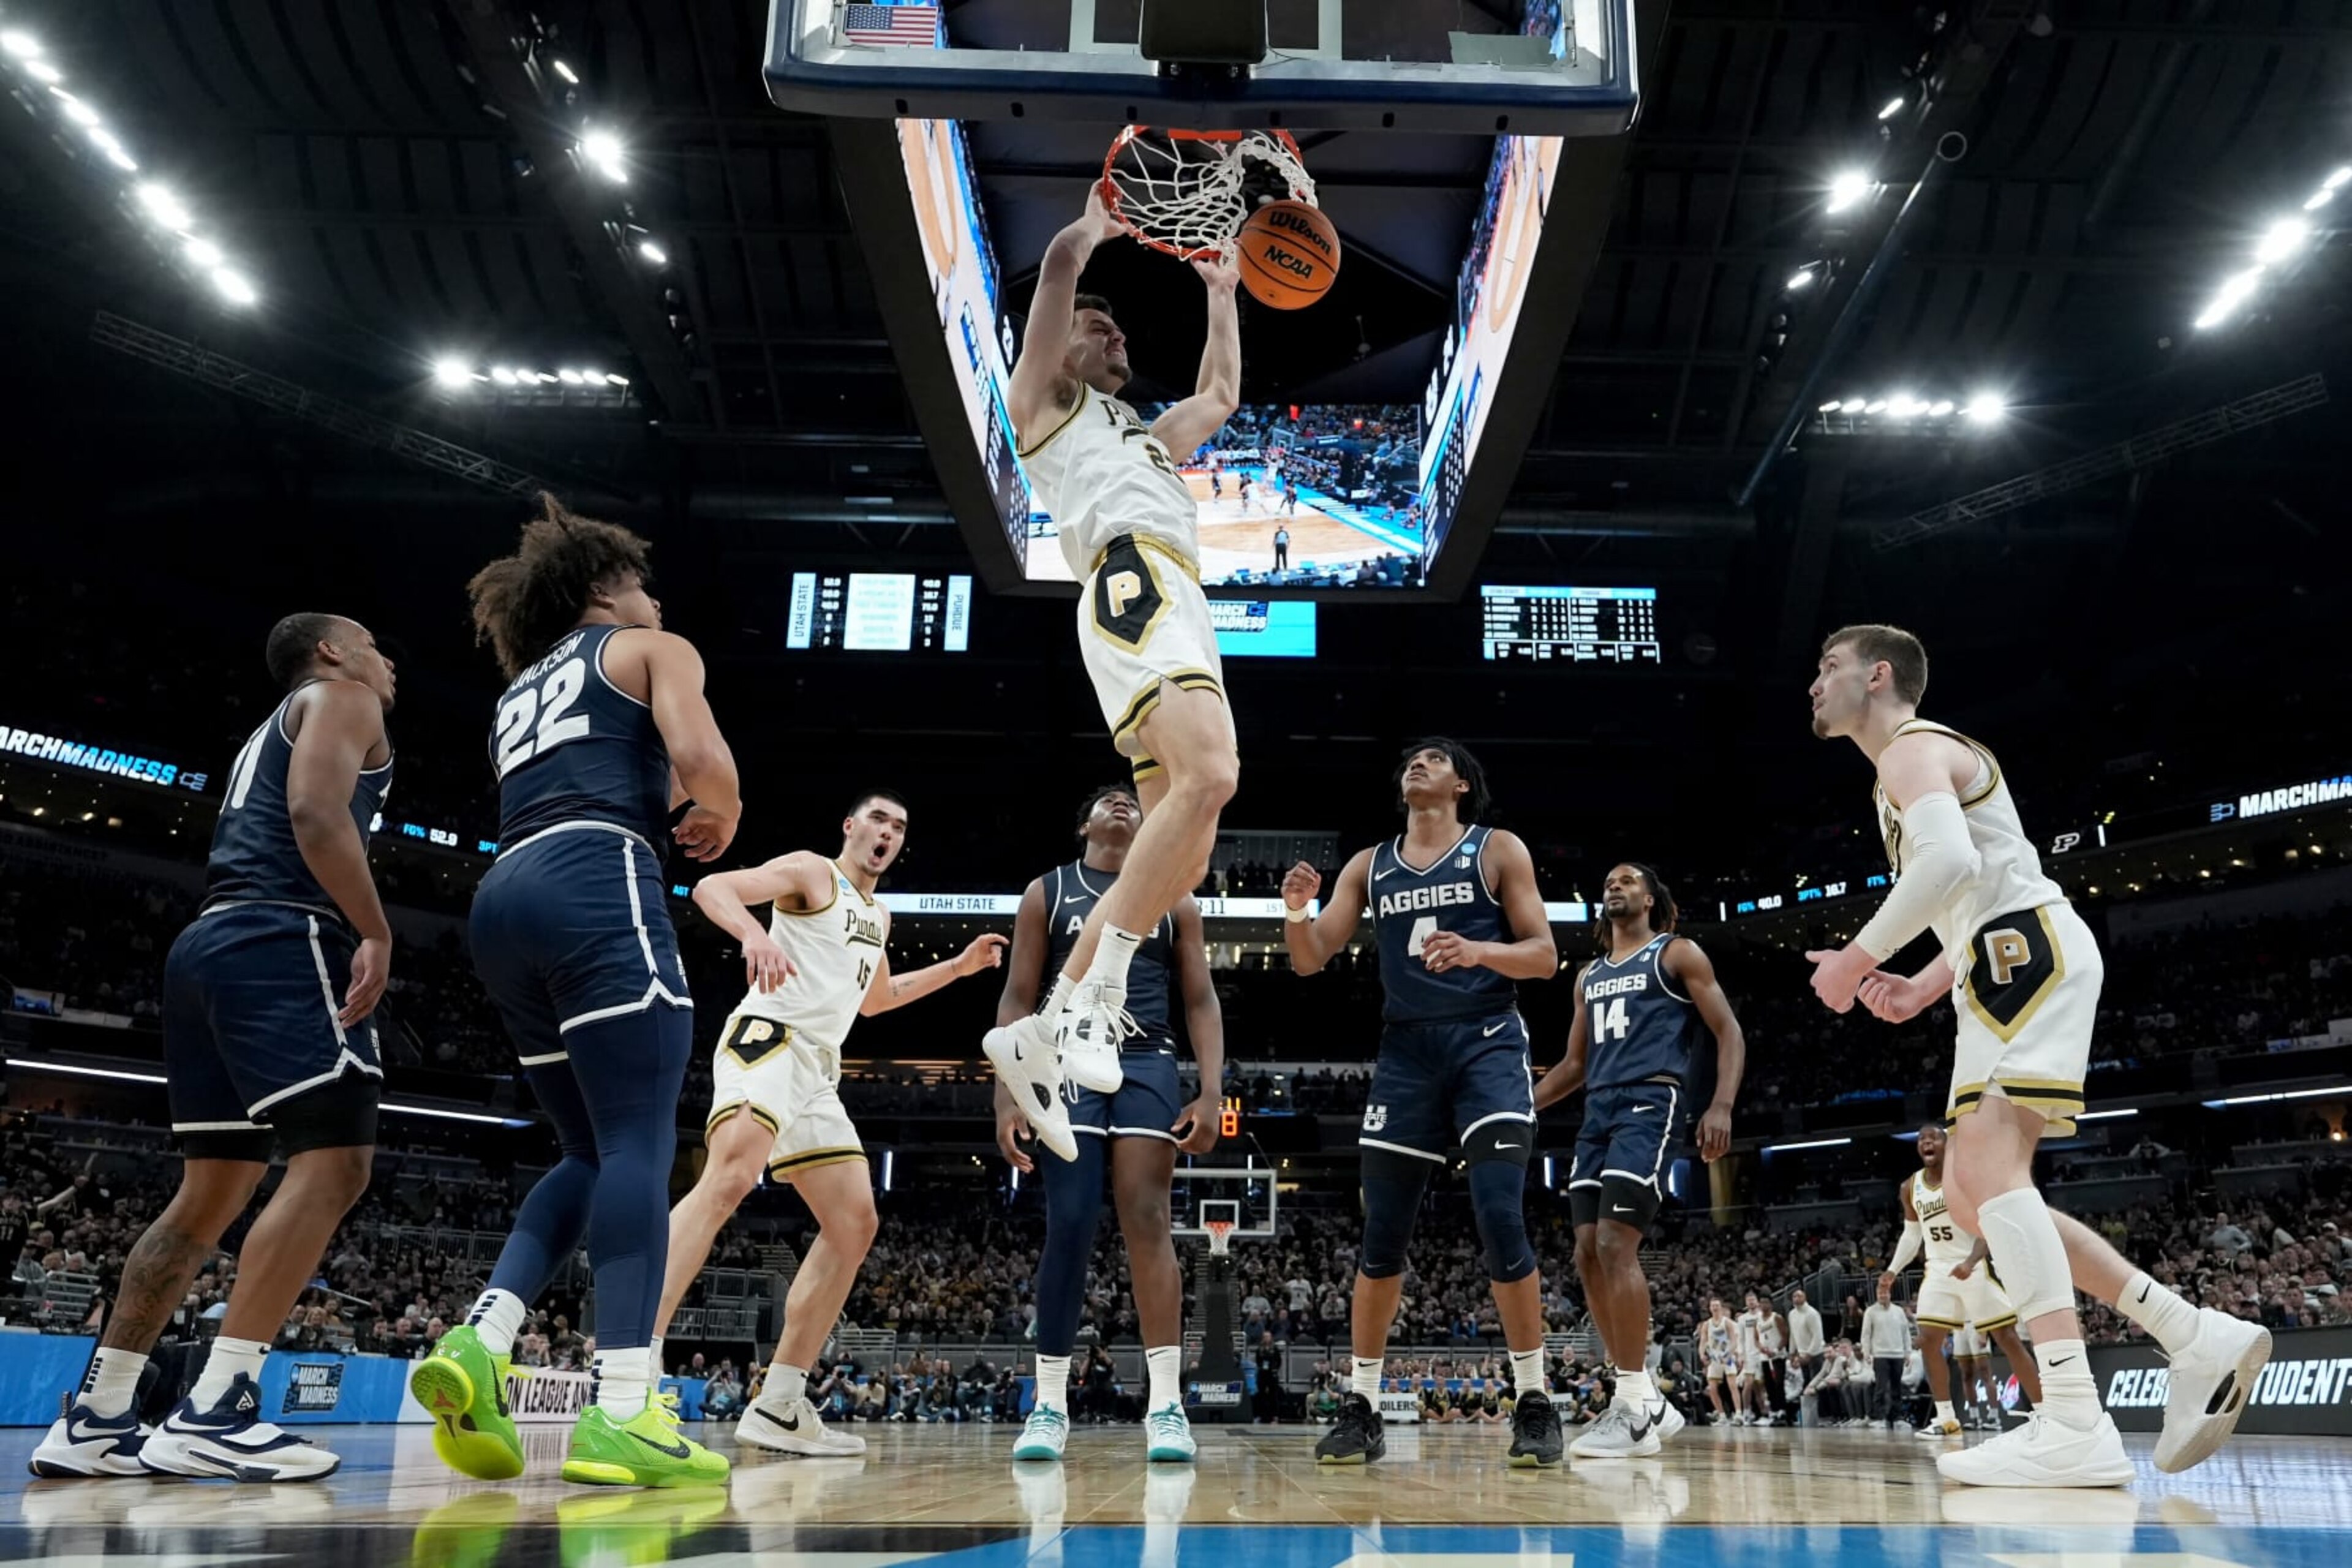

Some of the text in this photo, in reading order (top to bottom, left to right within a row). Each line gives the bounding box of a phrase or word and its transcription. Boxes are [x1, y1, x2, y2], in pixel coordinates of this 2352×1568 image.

[1270, 211, 1331, 255] Wilson
[1264, 245, 1314, 279] NCAA
[794, 584, 809, 638] UTAH STATE
[511, 632, 586, 691] JACKSON
[496, 657, 590, 778] 22
[919, 897, 995, 910] UTAH STATE
[1379, 881, 1474, 919] AGGIES
[1408, 916, 1438, 957] 4
[1983, 928, 2031, 984] P
[857, 958, 871, 991] 15
[1585, 973, 1646, 1004] AGGIES
[1594, 997, 1629, 1045] 14
[1929, 1226, 1953, 1242] 55
[298, 1366, 329, 1385] MARCH
[1199, 1383, 1227, 1392] MARCH
[298, 1385, 338, 1404] MADNESS
[524, 1377, 570, 1414] LEAGUE
[570, 1381, 592, 1414] AN
[1201, 1392, 1240, 1401] MADNESS
